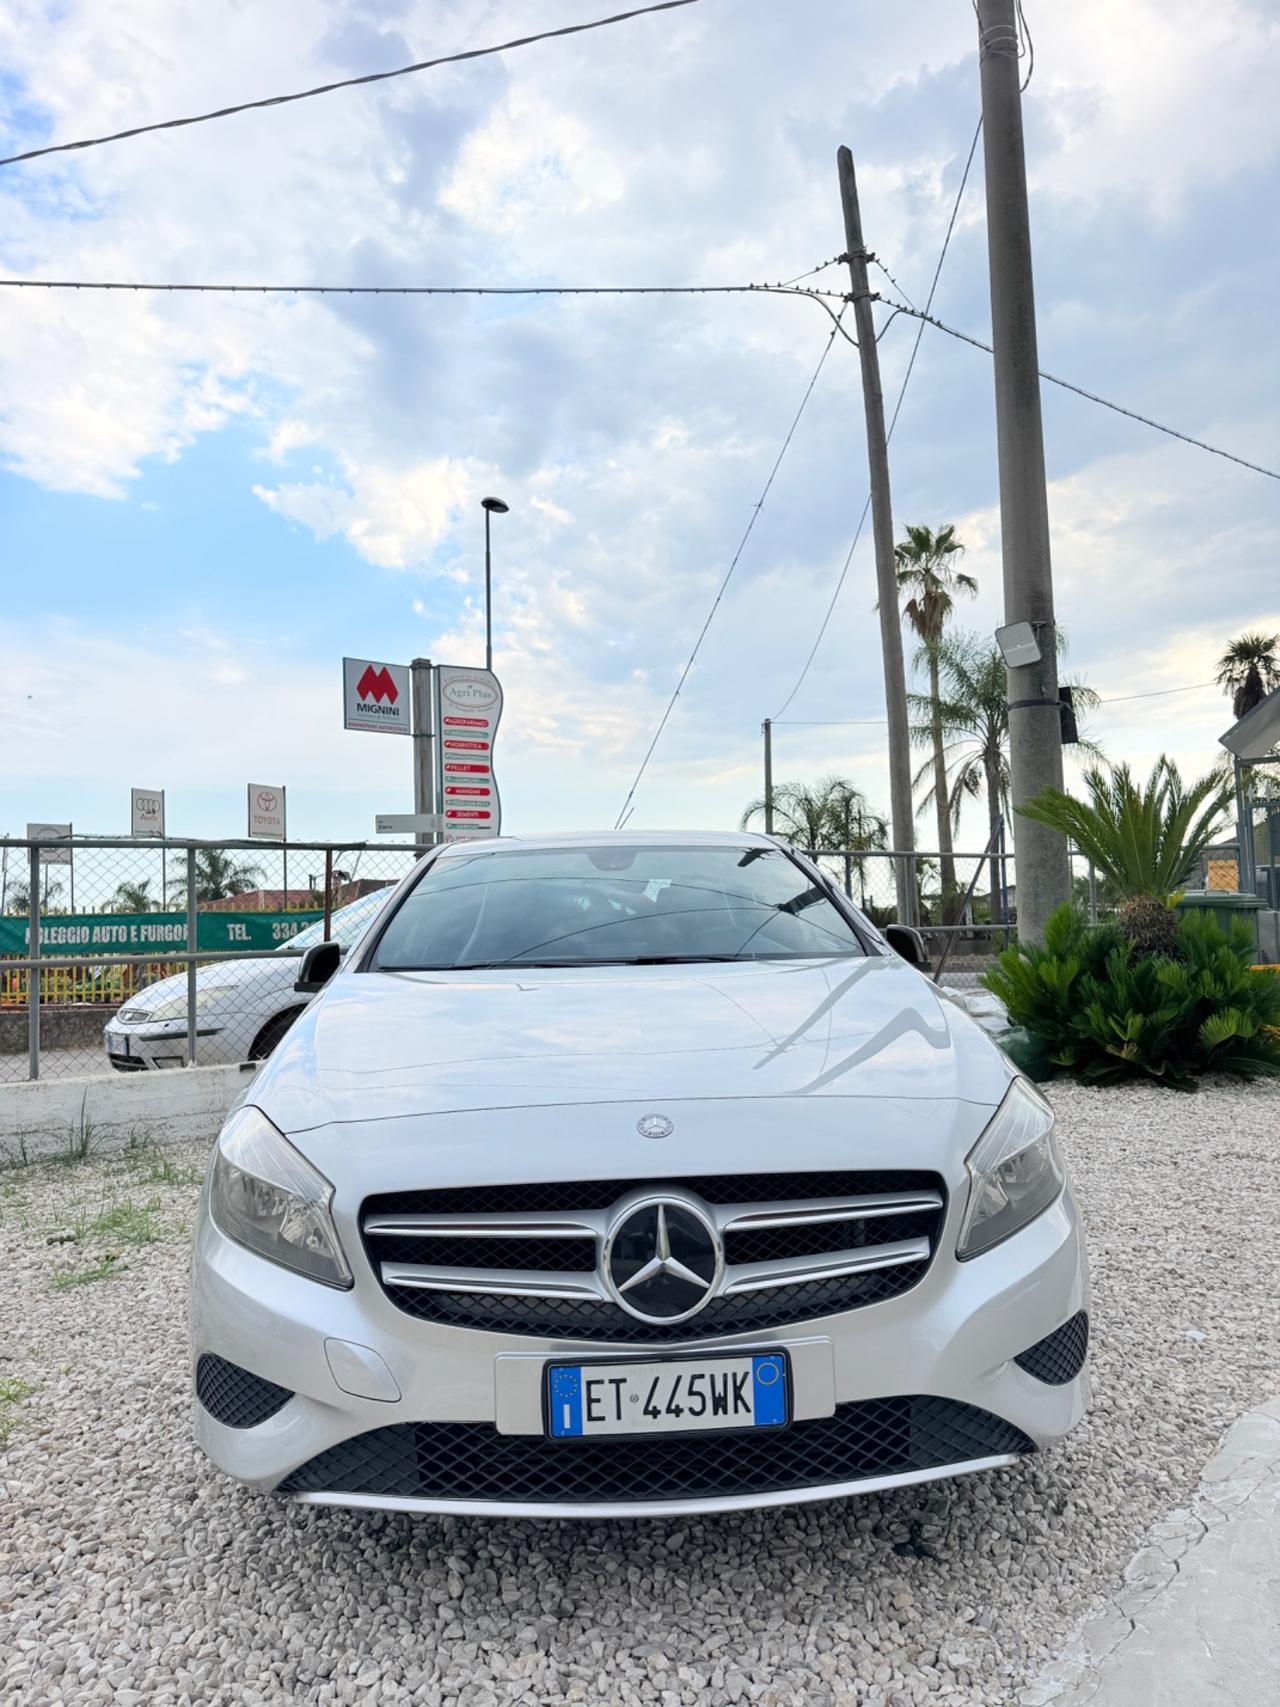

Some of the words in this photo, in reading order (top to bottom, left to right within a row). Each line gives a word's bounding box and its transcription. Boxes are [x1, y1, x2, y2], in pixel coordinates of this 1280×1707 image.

[356, 702, 400, 717] MIGNINI
[253, 814, 281, 826] TOYOTA
[92, 925, 127, 943] AUTO
[130, 925, 138, 942] E
[227, 923, 252, 941] TEL.
[585, 1377, 628, 1422] ET
[642, 1370, 752, 1419] 445WK
